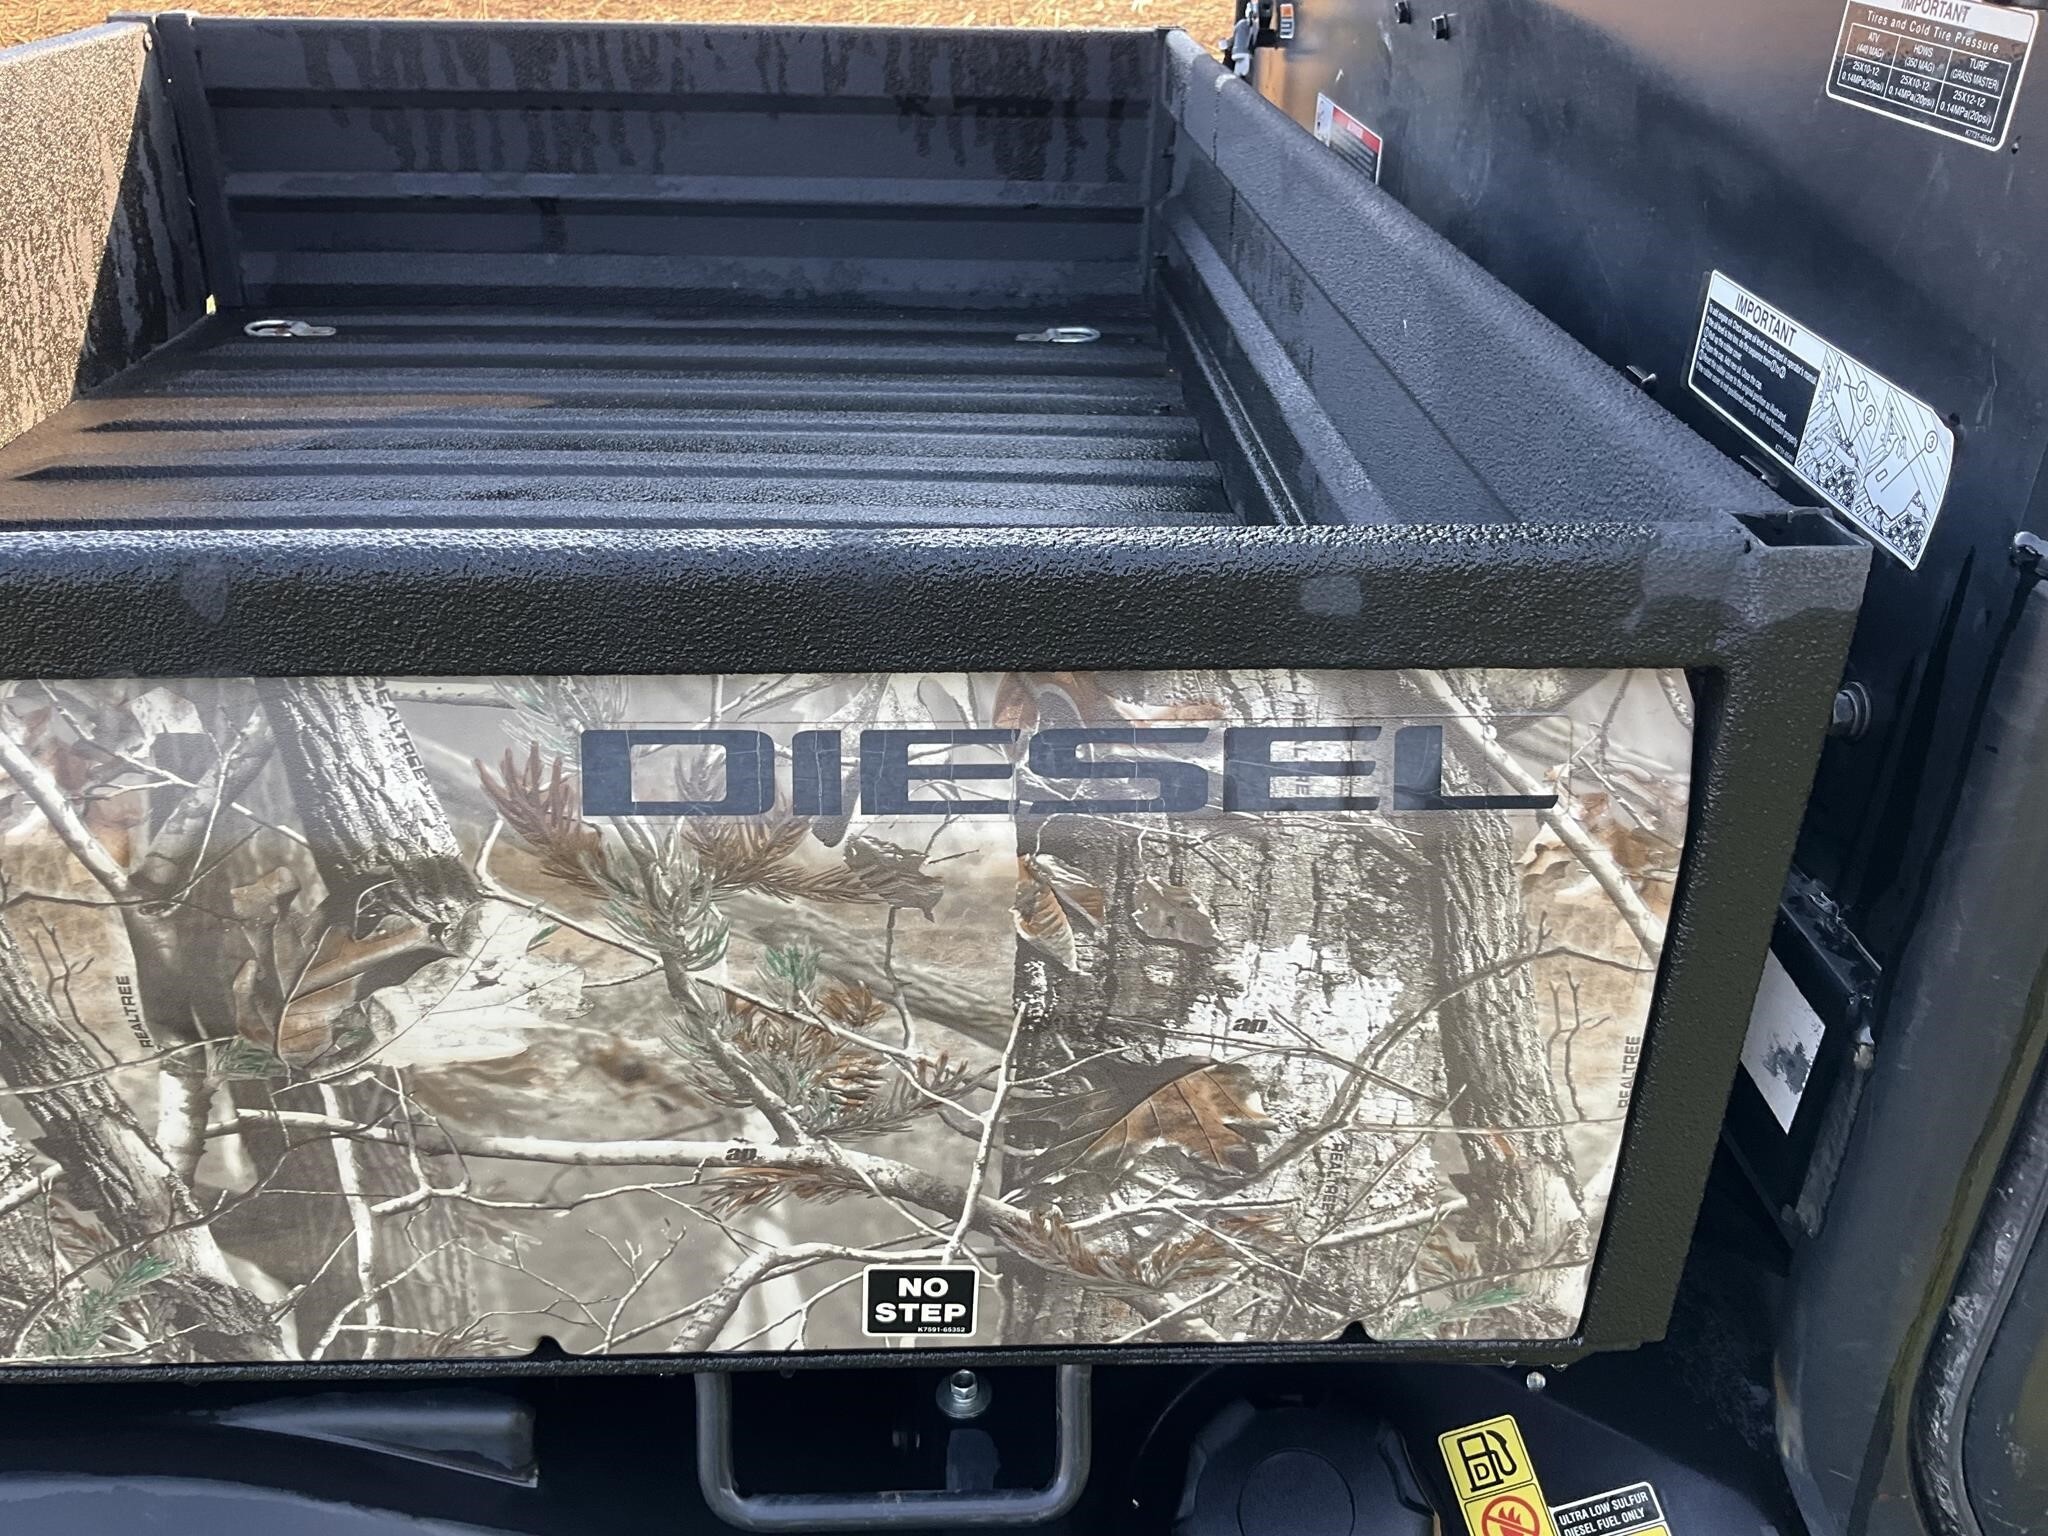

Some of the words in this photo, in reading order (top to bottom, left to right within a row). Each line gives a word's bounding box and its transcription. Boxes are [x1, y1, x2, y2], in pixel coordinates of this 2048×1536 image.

[1867, 10, 1888, 25] Tires
[1890, 18, 1907, 30] and
[1909, 20, 1931, 36] Cold
[1933, 26, 1952, 41] Tire
[1955, 31, 1999, 53] Pressure
[1969, 58, 1989, 71] TURF
[1952, 90, 1986, 107] 25X12-12
[1735, 293, 1797, 346] IMPORTANT
[581, 725, 1558, 817] DIESEL
[115, 975, 154, 1048] REALTREE
[1617, 1035, 1641, 1108] REALTREE
[1321, 1142, 1345, 1210] REALTREE
[898, 1277, 949, 1298] NO
[875, 1302, 966, 1323] STEP
[1473, 1462, 1490, 1481] D
[1559, 1507, 1590, 1526] ULTRA
[1589, 1502, 1611, 1518] LOW
[1611, 1491, 1648, 1510] SULFUR
[1564, 1522, 1597, 1536] DIESEL
[1597, 1515, 1621, 1531] FUEL
[1621, 1507, 1645, 1523] ONLY
